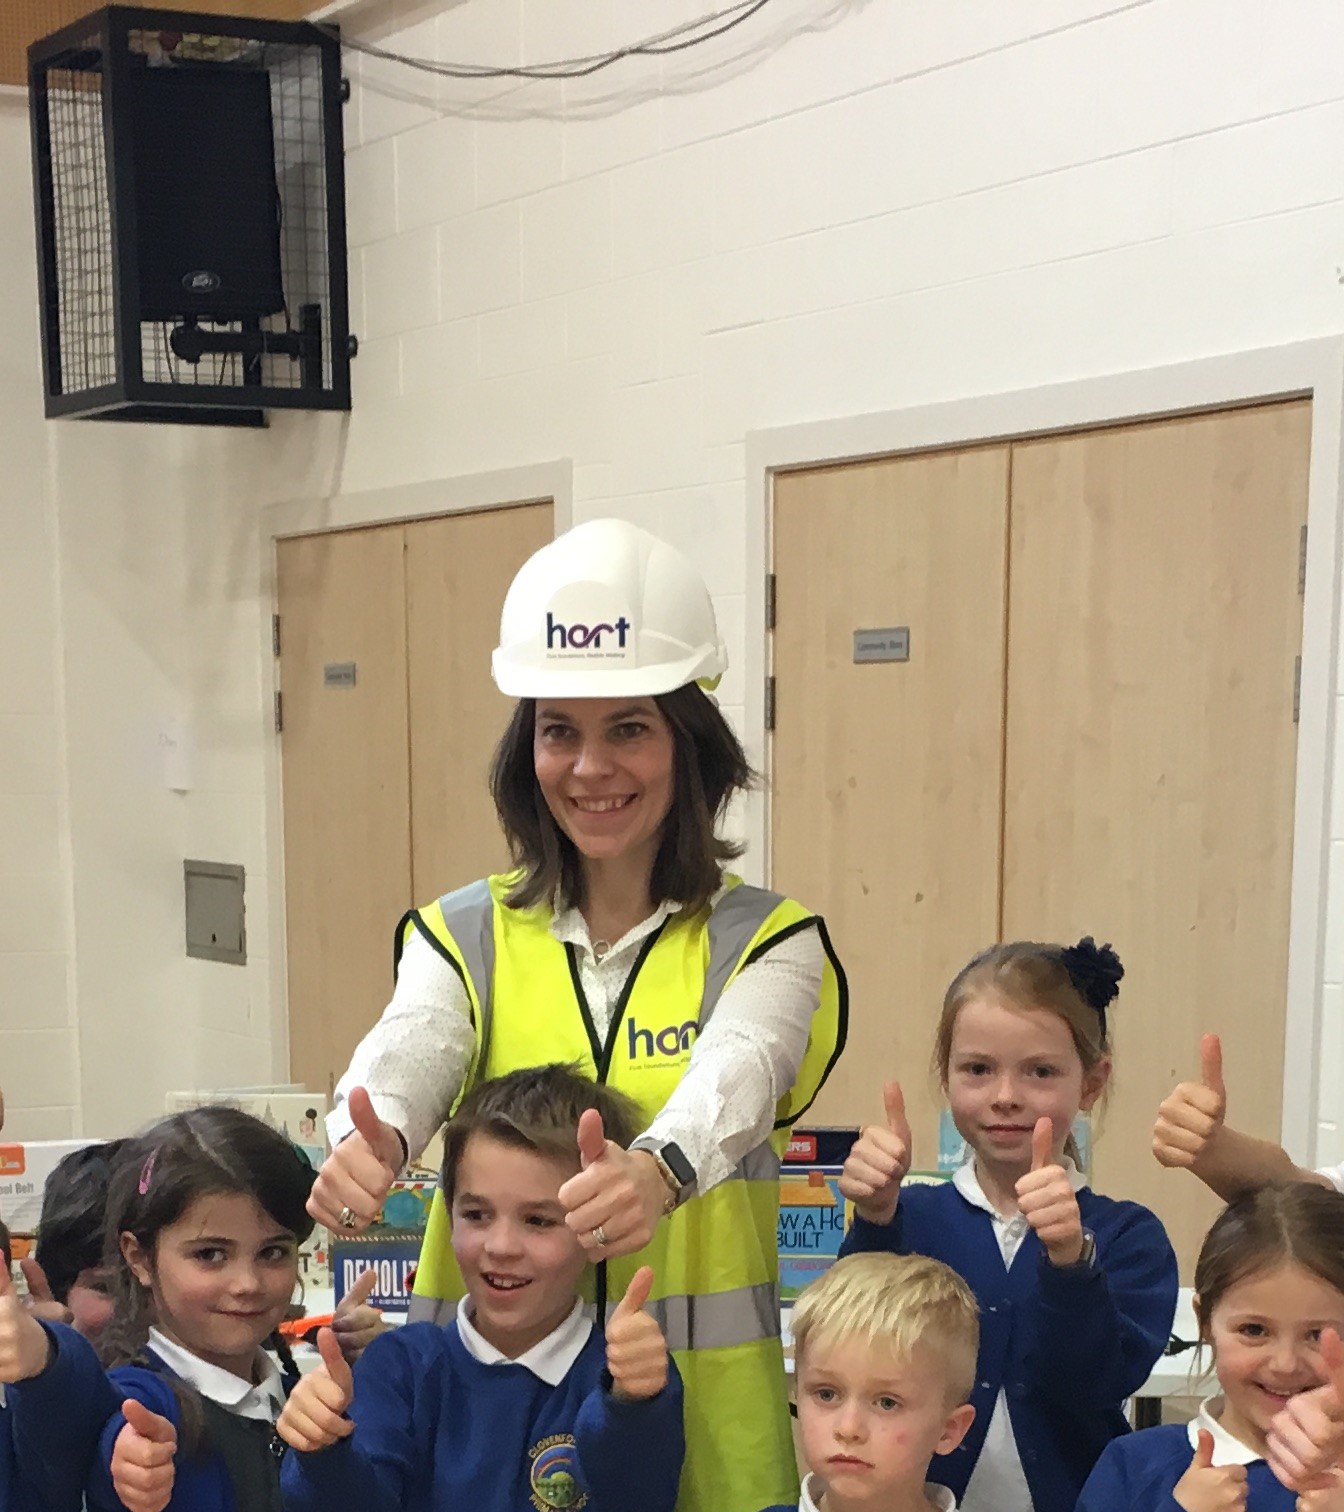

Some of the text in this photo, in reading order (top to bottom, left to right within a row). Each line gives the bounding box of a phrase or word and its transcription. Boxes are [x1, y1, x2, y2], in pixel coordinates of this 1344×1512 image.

[628, 1016, 698, 1060] har
[820, 1207, 845, 1231] HO
[777, 1231, 824, 1249] BUILT
[344, 1259, 418, 1298] DMOLIT
